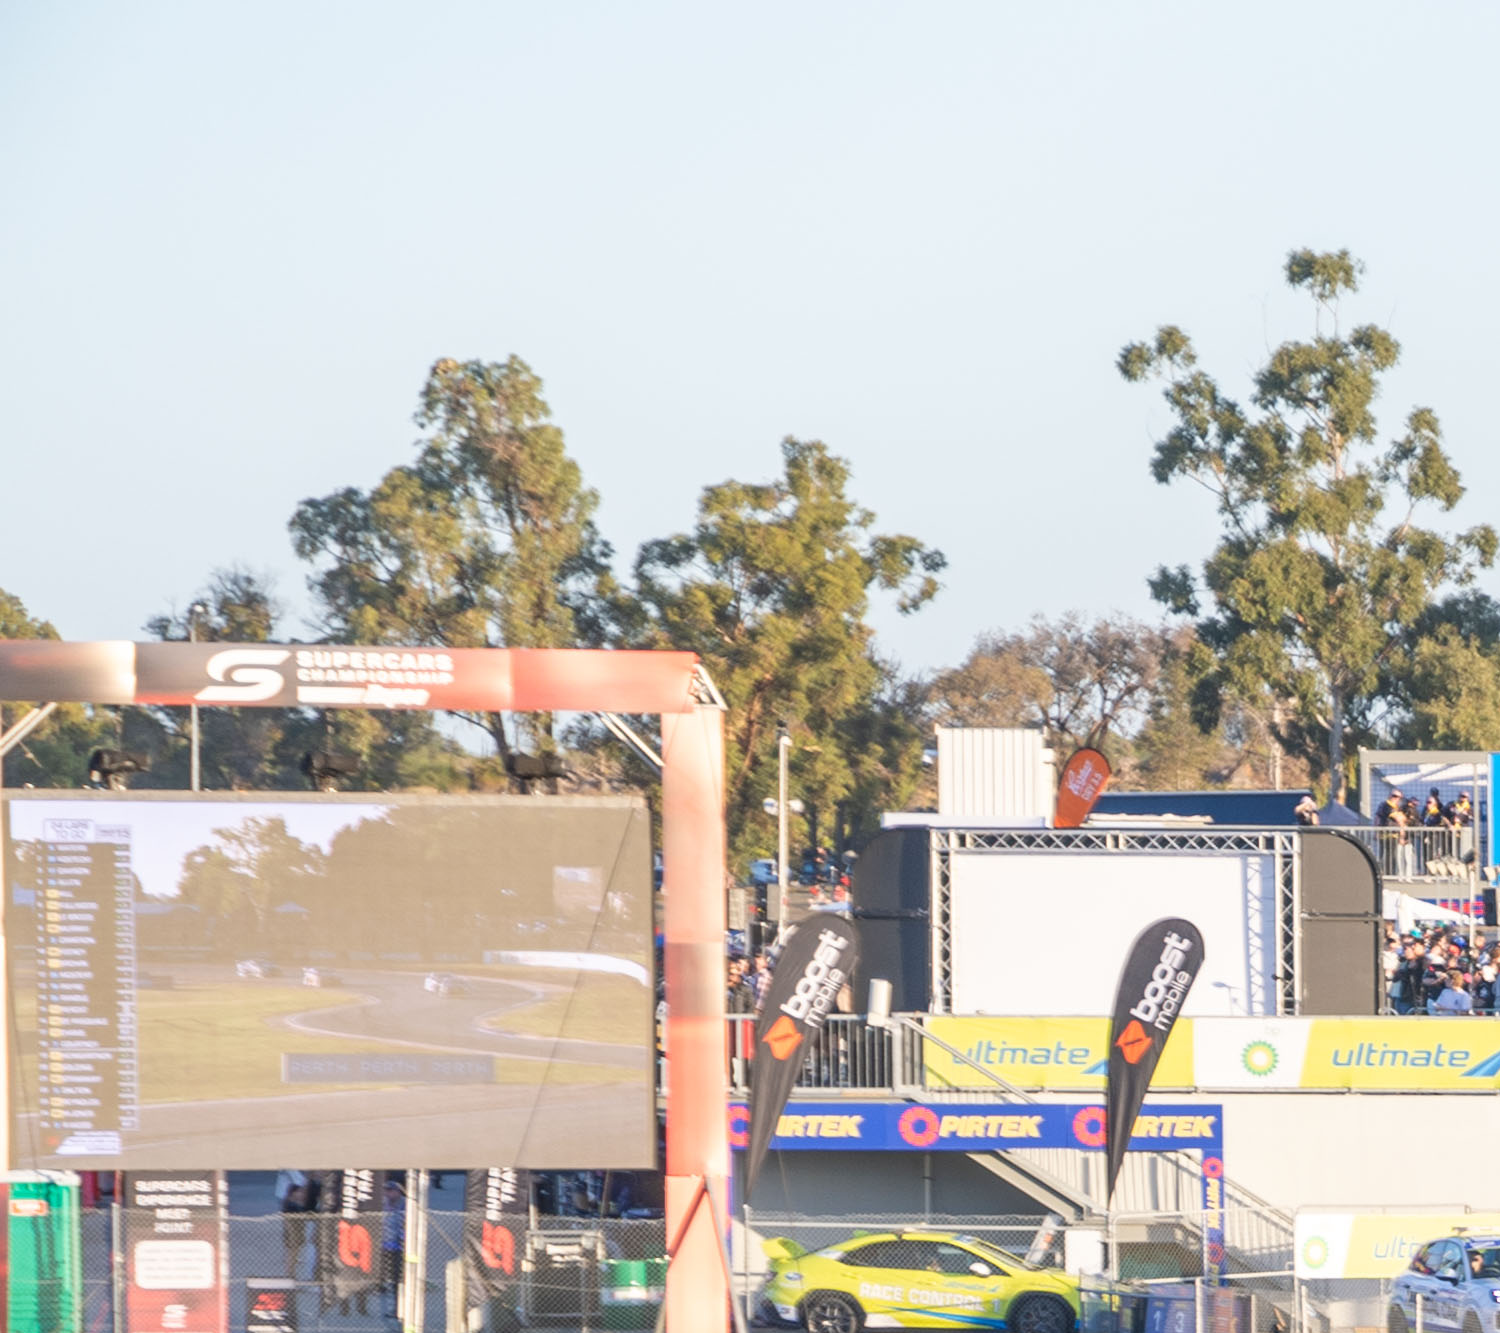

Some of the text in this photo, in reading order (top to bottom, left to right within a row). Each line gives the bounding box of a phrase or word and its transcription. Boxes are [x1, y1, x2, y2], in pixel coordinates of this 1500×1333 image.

[296, 650, 454, 671] SUPERCARS
[297, 669, 454, 684] CHAMPIONSHIP
[780, 928, 849, 1020] boost
[1129, 930, 1193, 1023] boost
[805, 968, 846, 1028] mobile
[1154, 970, 1192, 1032] mobile
[952, 1040, 1090, 1066] ultimate
[1332, 1041, 1471, 1069] ultimate
[291, 1060, 489, 1074] PERTH PERTH PERTH
[776, 1115, 864, 1137] IRTEK
[938, 1114, 1044, 1138] PIRTEK
[1131, 1115, 1217, 1138] IRTEK
[135, 1180, 211, 1192] SUPERCARS
[859, 1282, 904, 1301] RACE
[908, 1289, 985, 1312] CONTROL
[1174, 1311, 1186, 1333] 3
